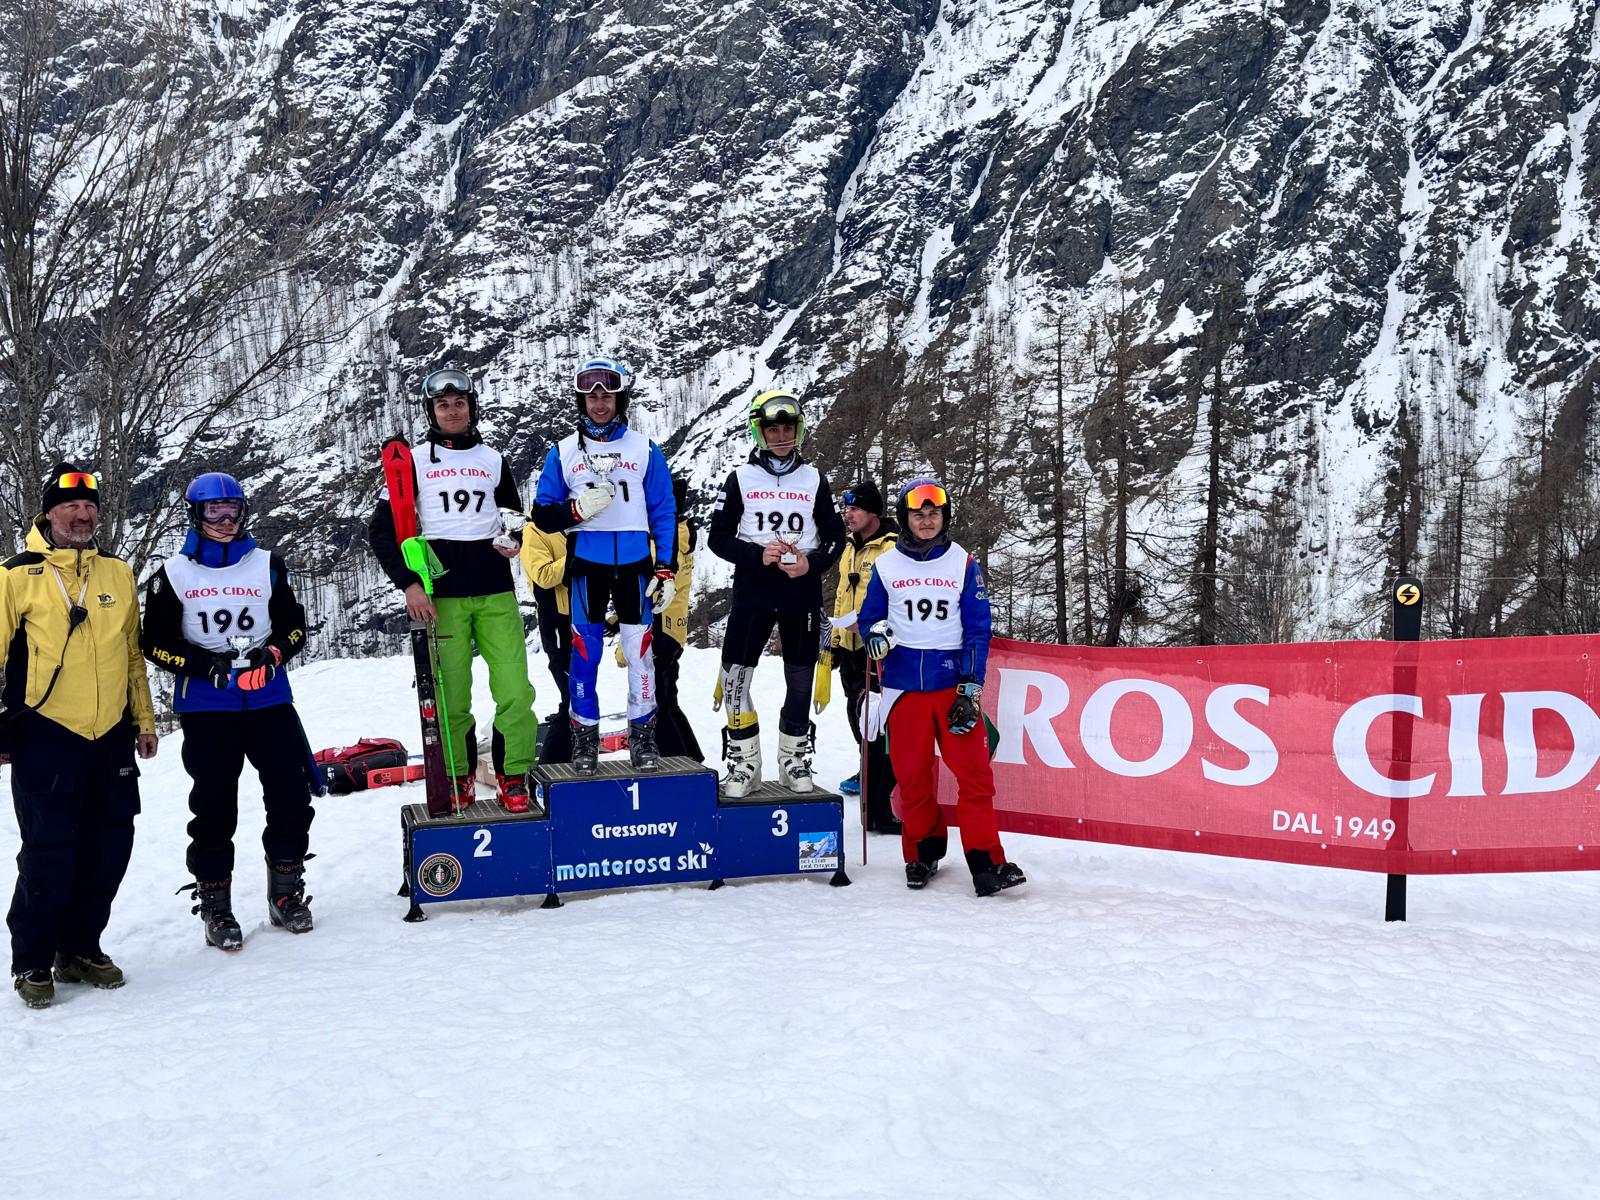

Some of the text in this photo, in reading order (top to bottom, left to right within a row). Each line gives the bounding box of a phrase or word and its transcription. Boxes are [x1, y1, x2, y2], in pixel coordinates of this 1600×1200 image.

[426, 468, 457, 479] GROS
[439, 489, 486, 513] 197
[747, 491, 811, 501] GROS CIDAC
[755, 511, 804, 531] 190
[185, 586, 262, 599] GROS CIDAC
[892, 578, 958, 589] GROS CIDAC
[198, 607, 255, 634] 196
[904, 598, 949, 621] 195
[992, 667, 1600, 799] ROS CID
[627, 782, 639, 810] 1
[591, 821, 678, 839] Gressoney
[772, 809, 788, 836] 3
[1272, 809, 1396, 841] DAL 1949
[473, 829, 492, 857] 2
[556, 849, 708, 882] monterosa ski
